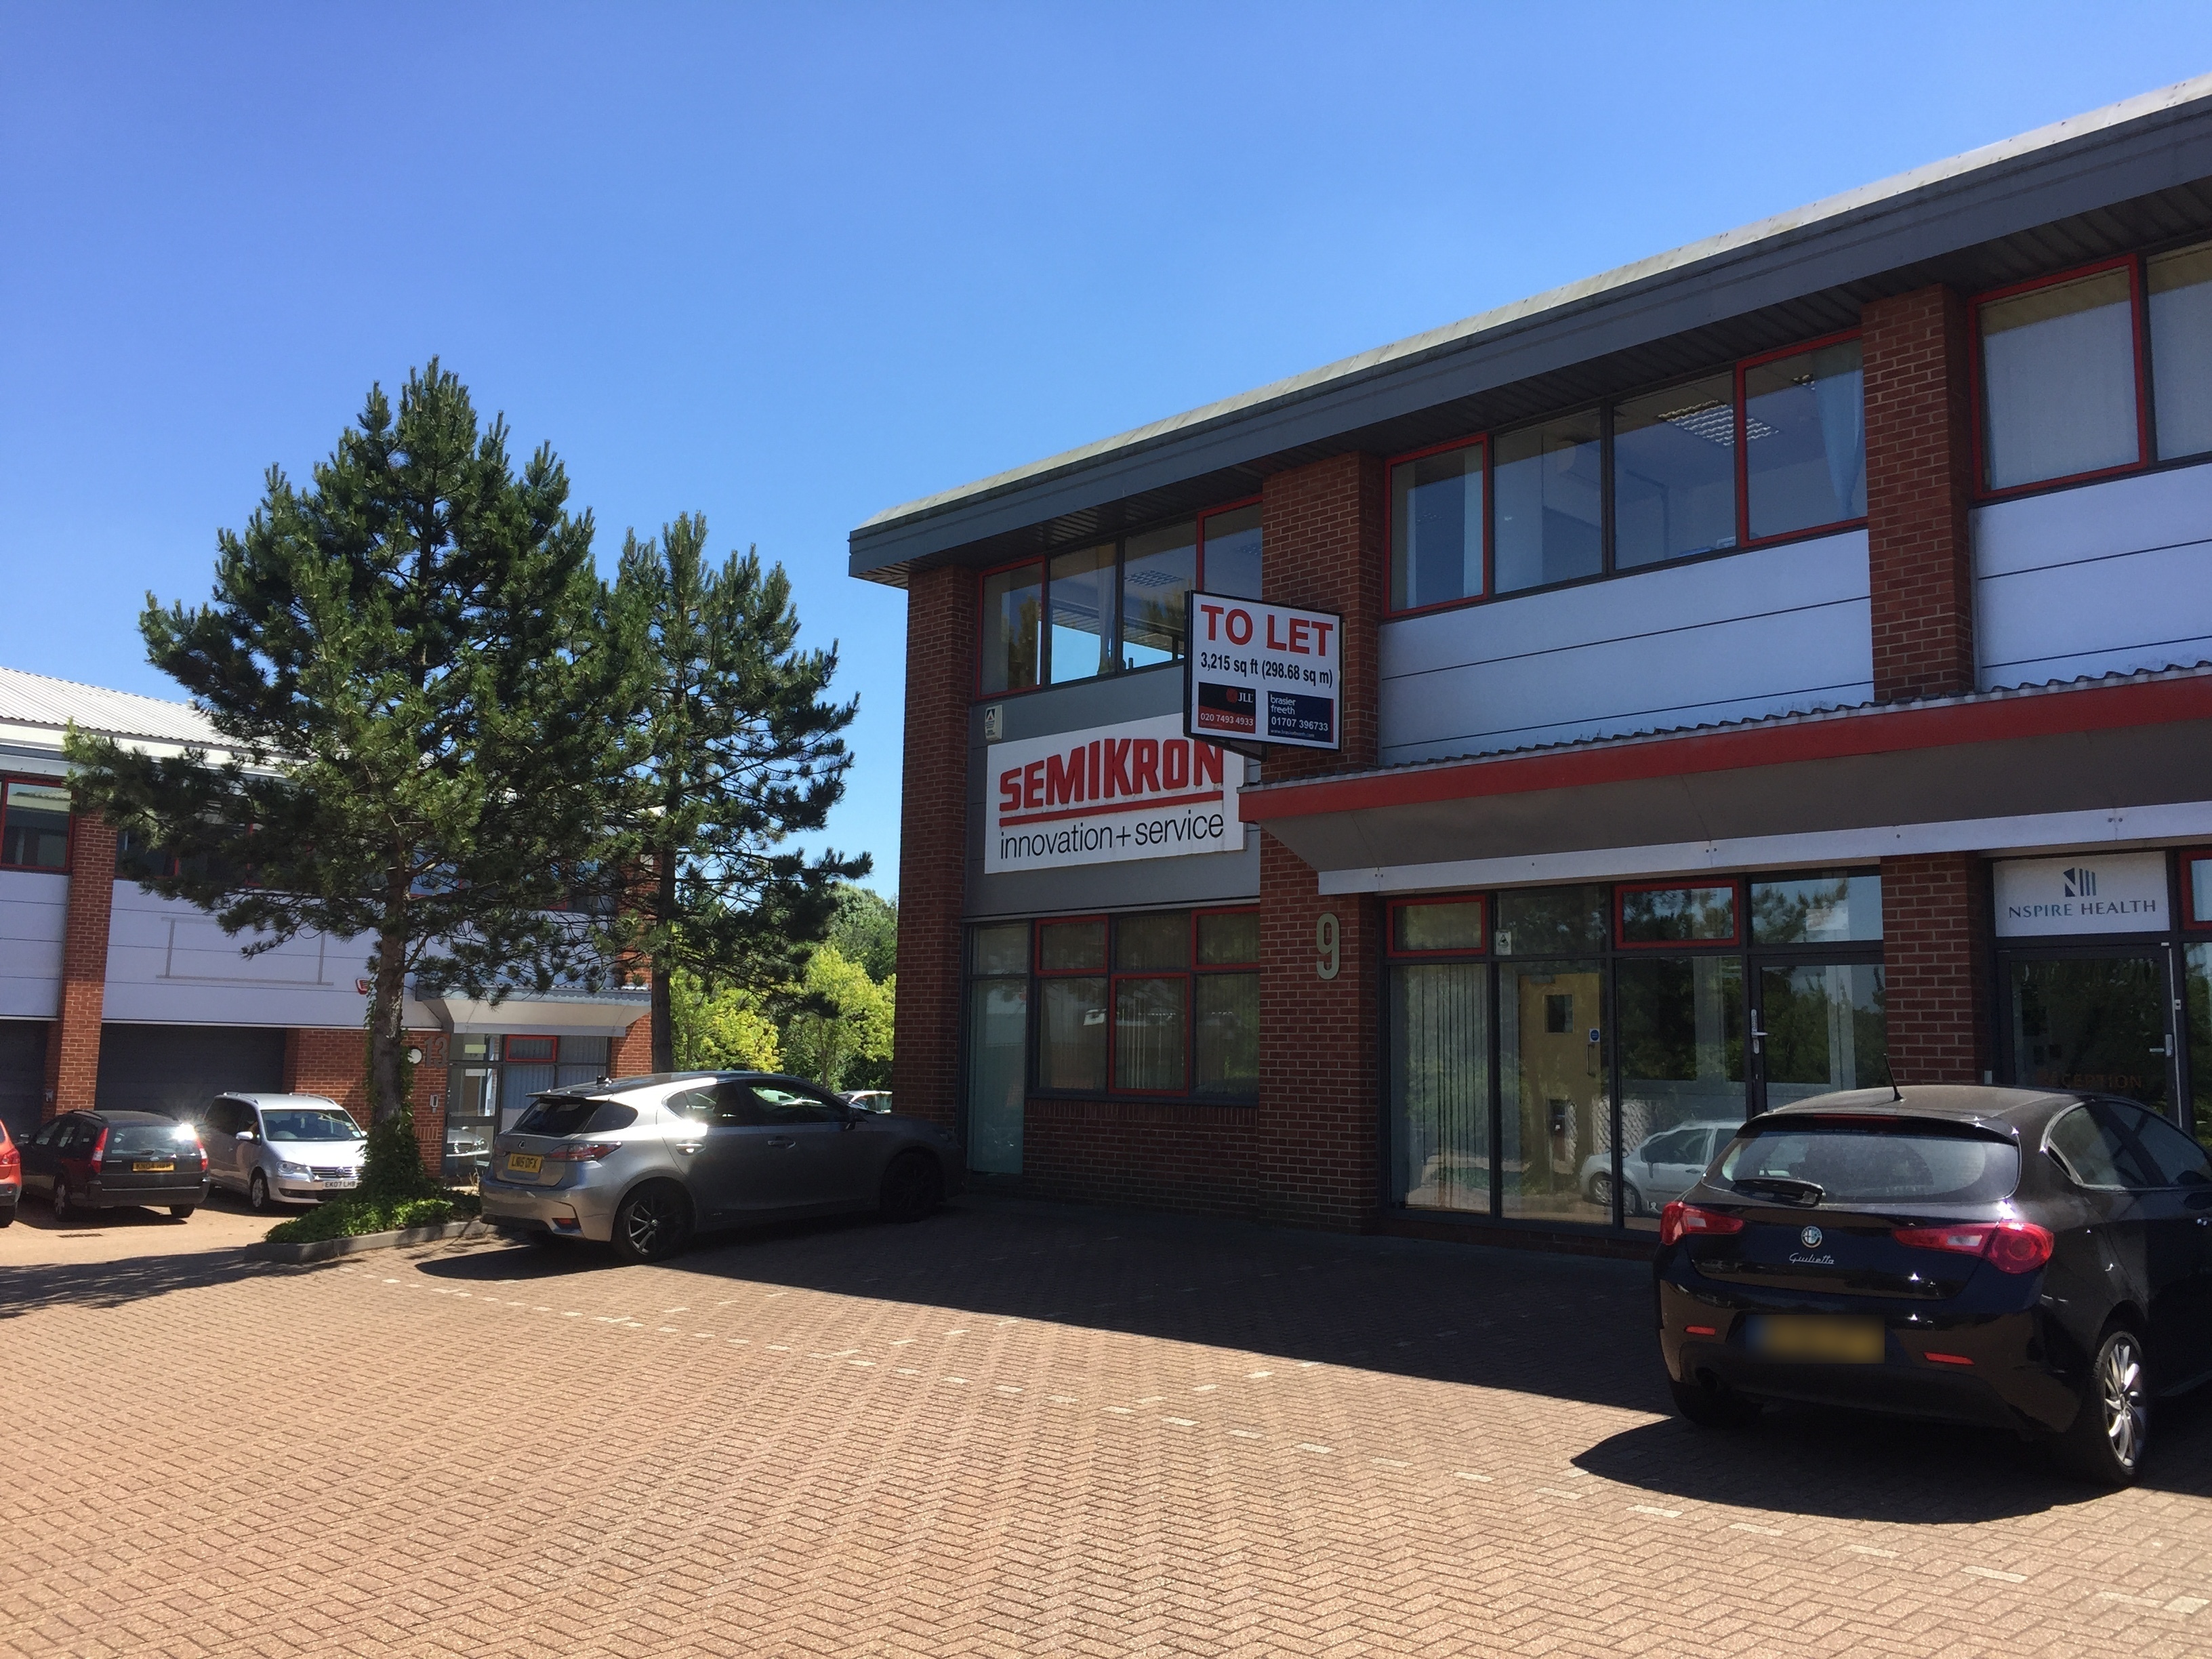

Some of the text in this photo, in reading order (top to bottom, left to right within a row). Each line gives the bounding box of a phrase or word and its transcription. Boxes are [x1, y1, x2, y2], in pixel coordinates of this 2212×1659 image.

[1201, 604, 1333, 657] TO LET
[1201, 652, 1333, 688] 3,215 sq ft (298.68 sq m)
[1237, 692, 1253, 703] JLL
[1270, 694, 1296, 705] brasier
[1271, 704, 1295, 715] freeth
[1200, 713, 1253, 726] 020 7493 4933
[1271, 716, 1328, 731] 01707 396733
[1000, 738, 1223, 811] SEMIKRON
[2009, 899, 2156, 918] NSPIRE HEALTH
[1316, 913, 1340, 980] 9
[424, 1036, 447, 1069] 13
[1789, 1252, 1835, 1265] Giulietta
